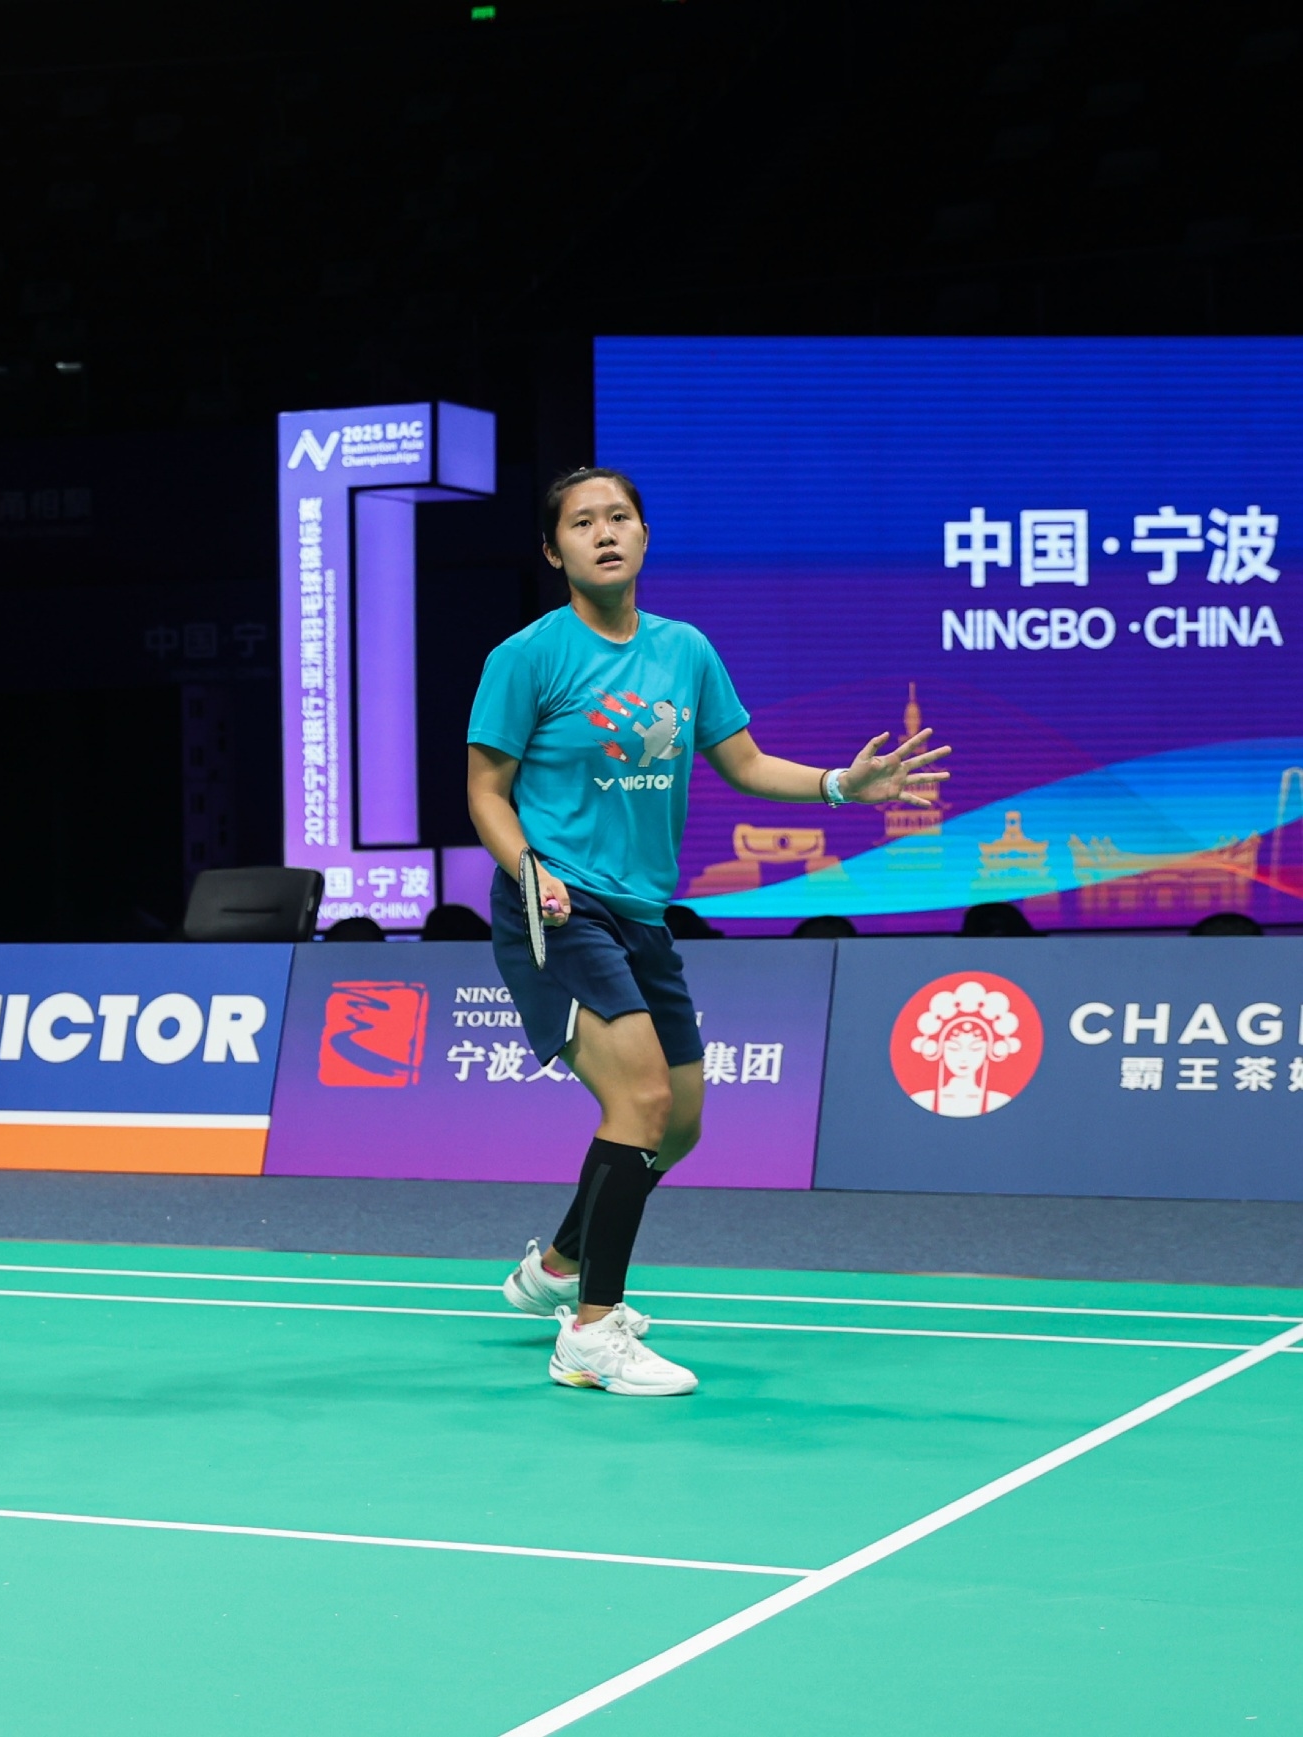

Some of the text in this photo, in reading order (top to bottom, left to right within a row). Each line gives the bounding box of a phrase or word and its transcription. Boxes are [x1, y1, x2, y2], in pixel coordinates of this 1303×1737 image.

[342, 421, 423, 442] 2025 BAC
[342, 439, 424, 456] Badminton Asia
[342, 451, 420, 468] Championships
[943, 504, 1281, 588] 中国·宁波
[941, 606, 1117, 651] NINGBO
[454, 986, 514, 1004] NING
[1069, 1001, 1303, 1046] CHAG
